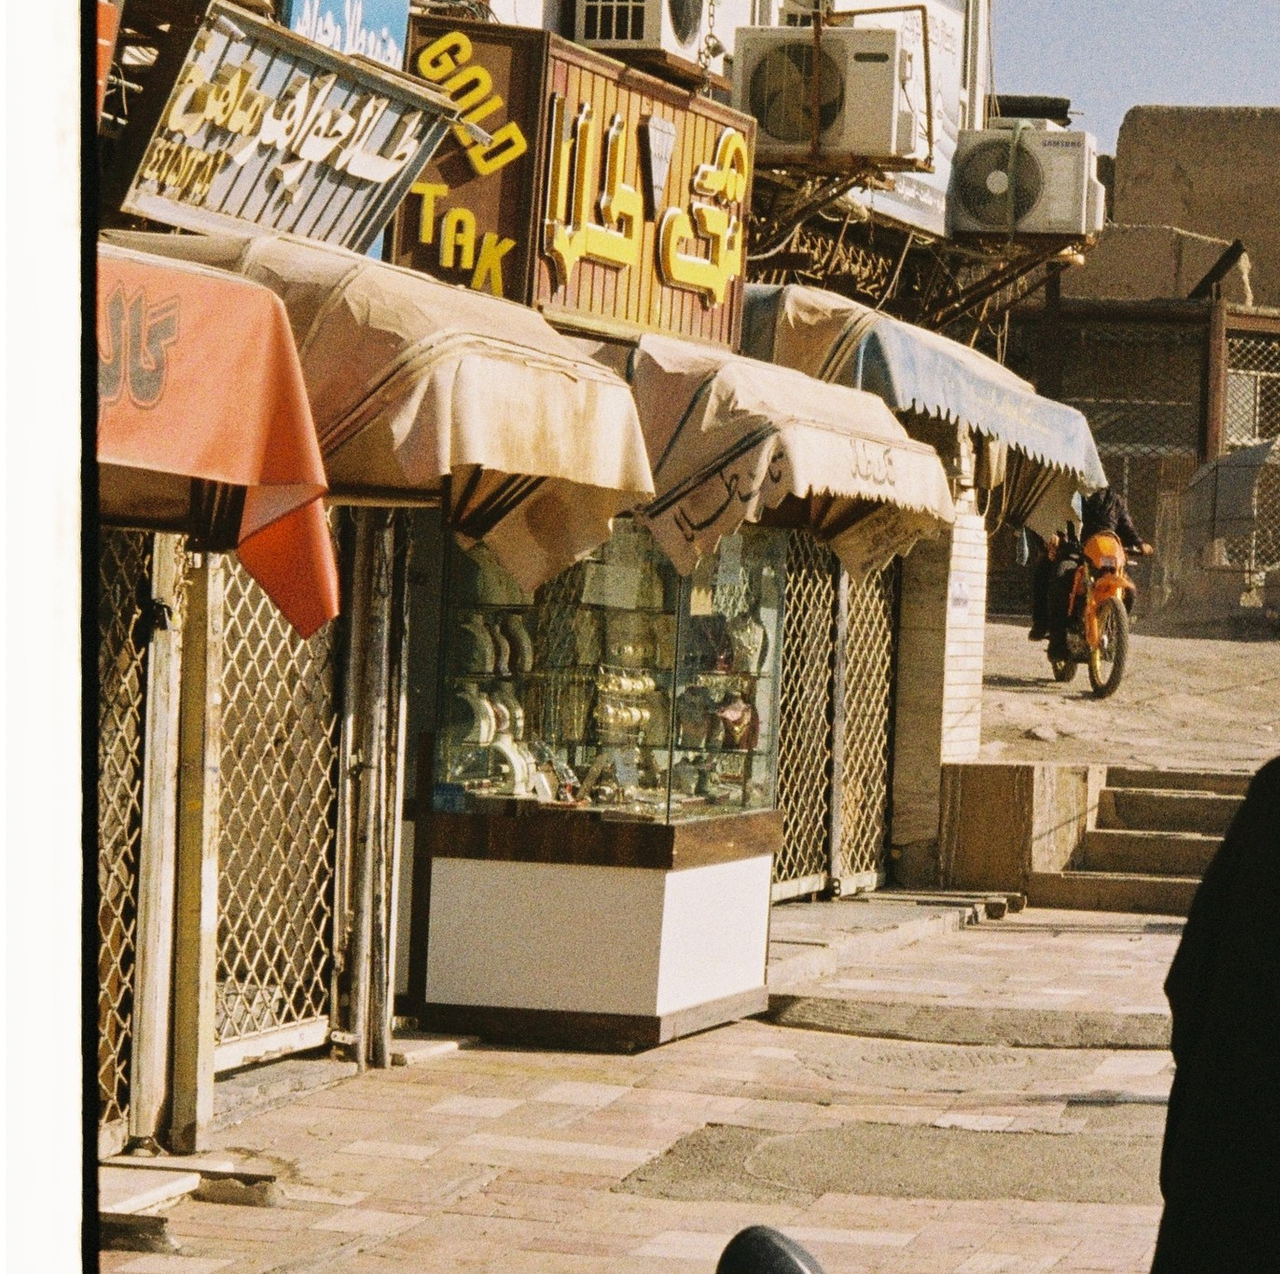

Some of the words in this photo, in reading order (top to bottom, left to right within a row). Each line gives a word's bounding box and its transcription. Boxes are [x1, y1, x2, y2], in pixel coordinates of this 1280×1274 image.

[232, 73, 357, 204] جواهر
[334, 94, 424, 183] طلا
[417, 30, 528, 177] GOLD
[1042, 139, 1083, 148] SAMSUNG
[411, 181, 518, 300] TAK
[544, 93, 644, 287] طلا
